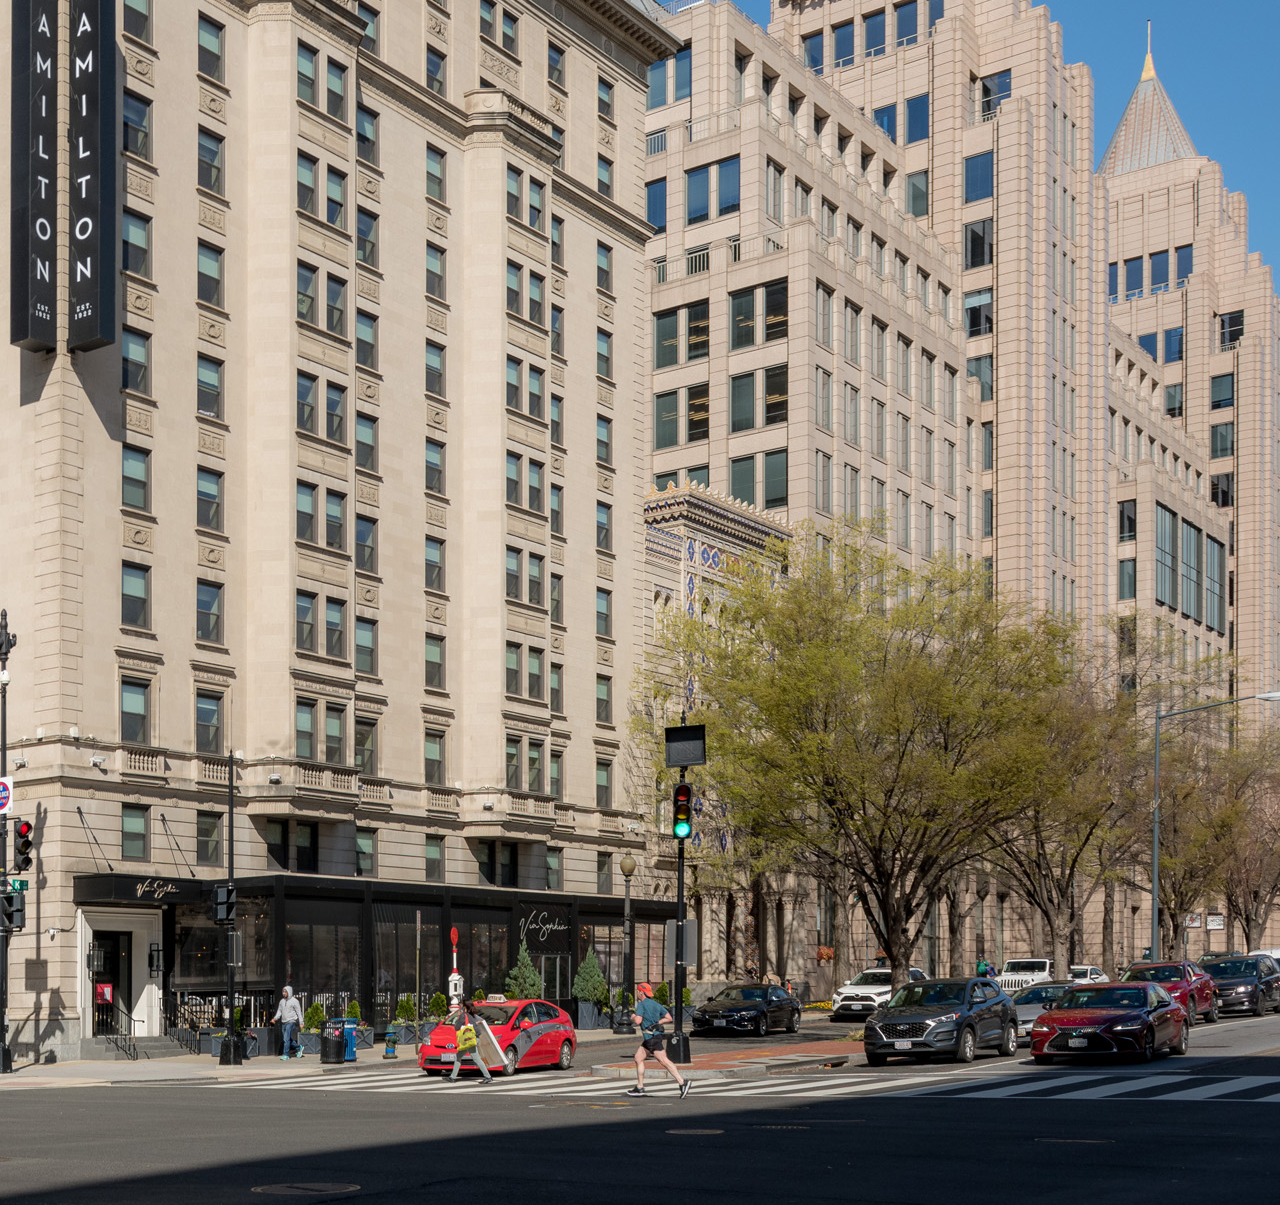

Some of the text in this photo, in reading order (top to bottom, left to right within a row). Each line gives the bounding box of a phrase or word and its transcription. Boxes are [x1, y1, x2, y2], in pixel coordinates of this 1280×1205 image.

[37, 303, 51, 314] EST.
[76, 302, 92, 313] EST.
[35, 309, 50, 321] 1922
[74, 309, 92, 320] 1922
[15, 880, 21, 890] K
[519, 910, 568, 941] Via Sophia
